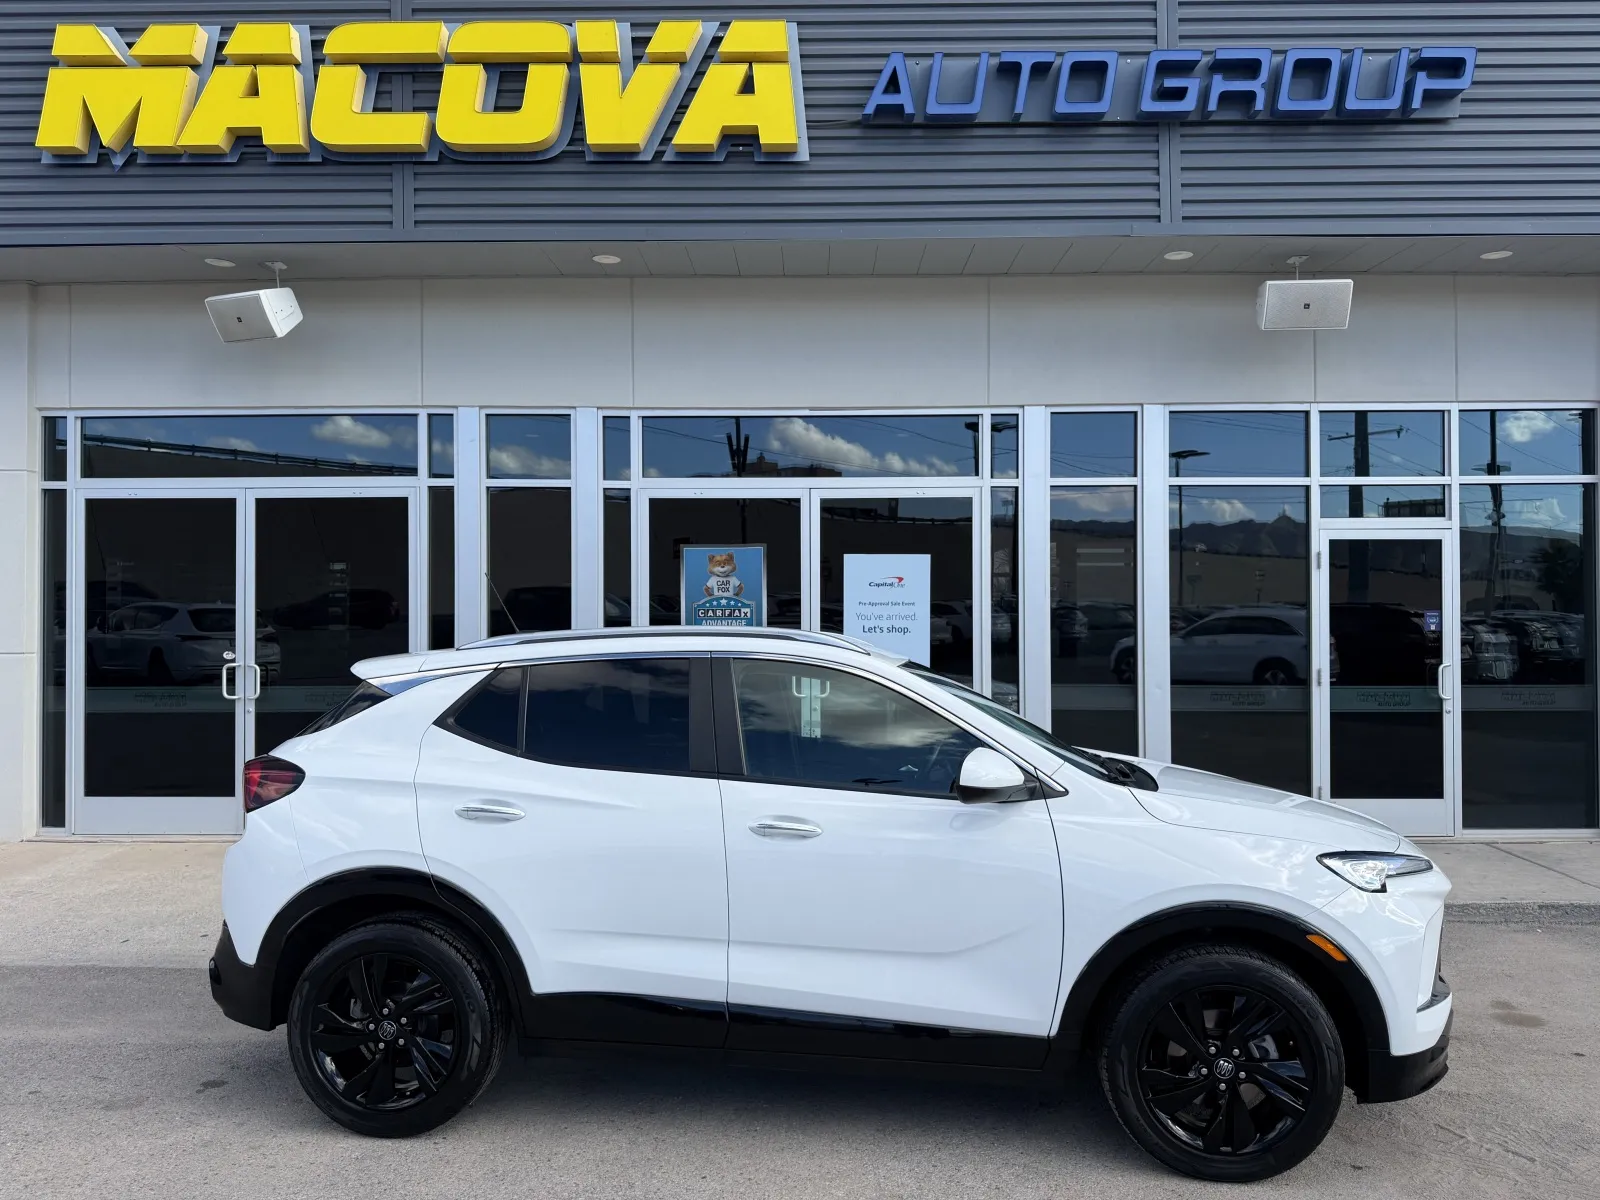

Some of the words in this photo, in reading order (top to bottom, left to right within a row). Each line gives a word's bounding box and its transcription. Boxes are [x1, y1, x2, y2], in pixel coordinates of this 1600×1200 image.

[34, 19, 799, 156] MACOVA
[861, 50, 1119, 122] AUTO
[1136, 46, 1478, 120] GROUP
[698, 609, 749, 618] CARFAX
[855, 612, 884, 621] You've
[886, 612, 918, 621] arrived.
[862, 625, 884, 633] Let's
[886, 625, 911, 635] shop.
